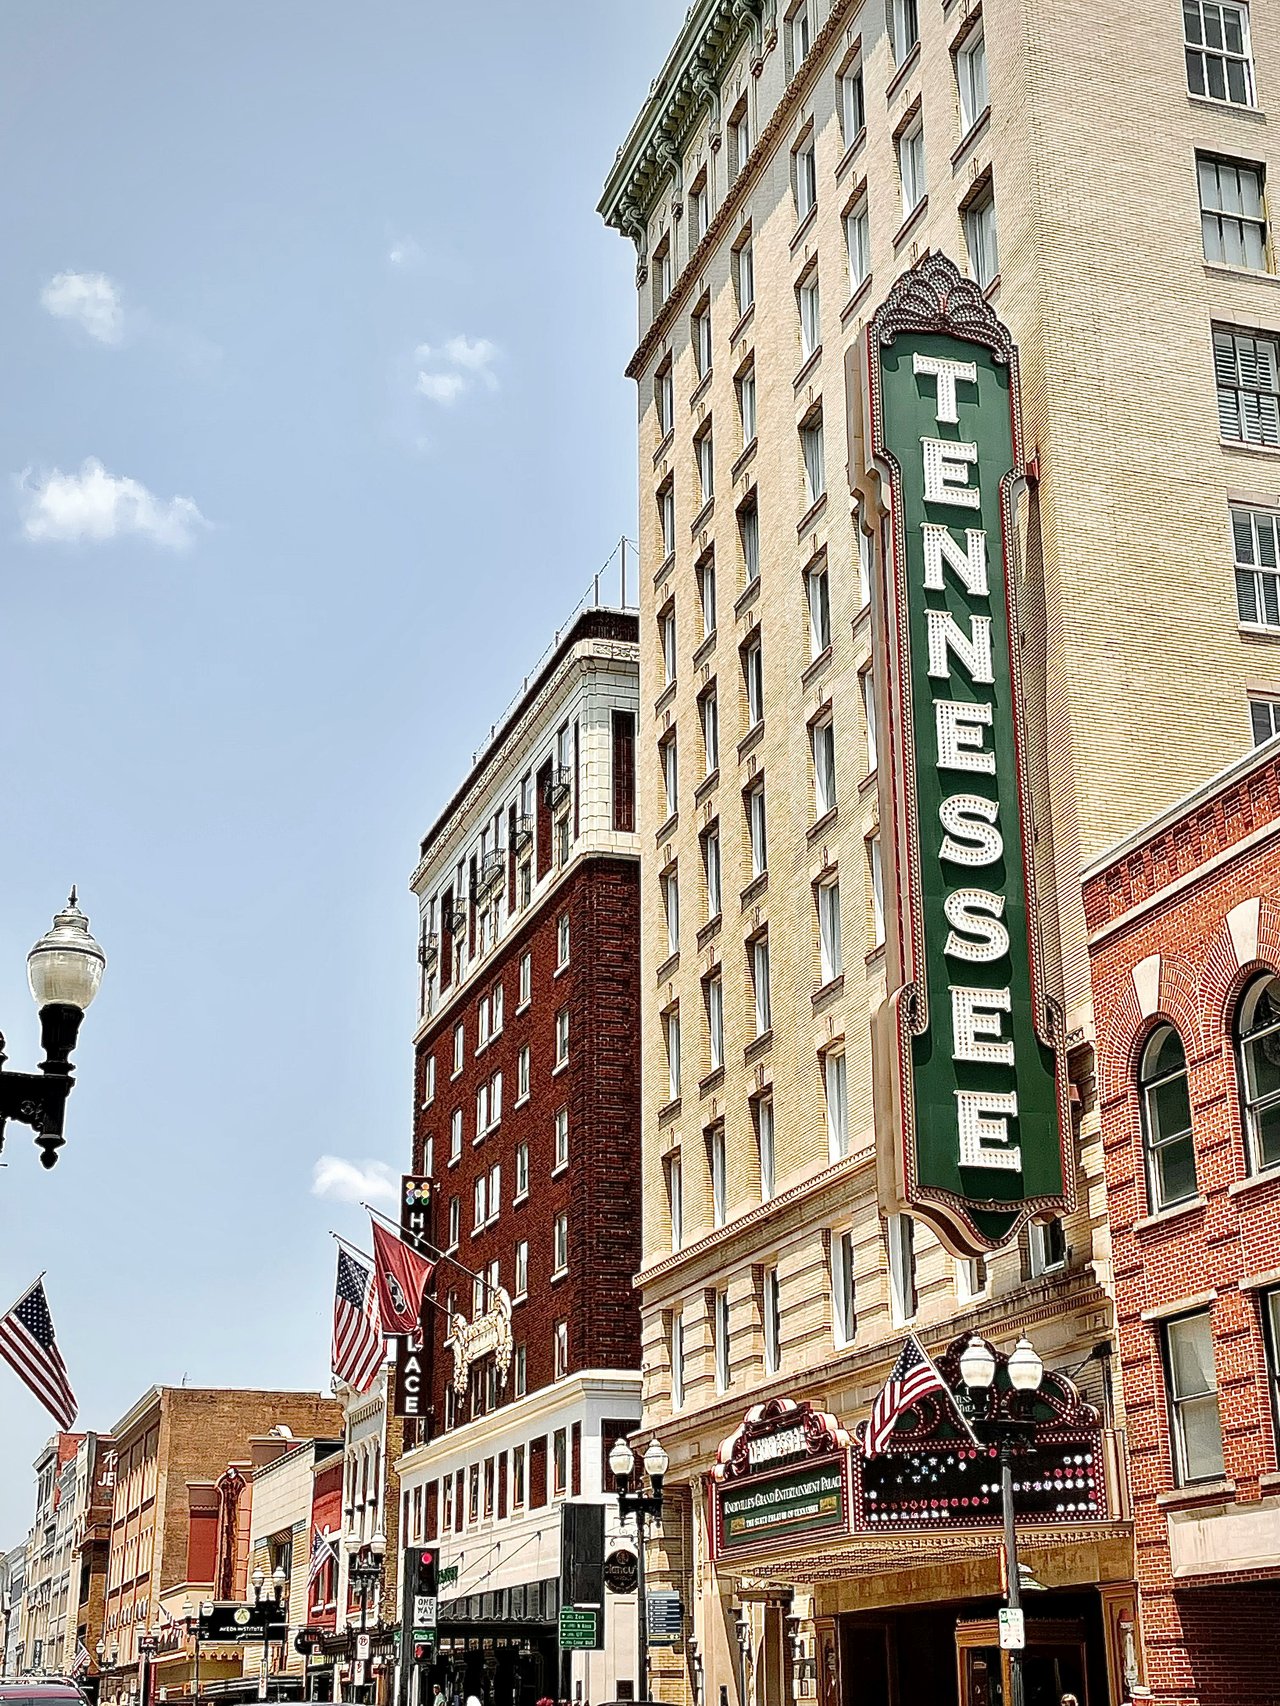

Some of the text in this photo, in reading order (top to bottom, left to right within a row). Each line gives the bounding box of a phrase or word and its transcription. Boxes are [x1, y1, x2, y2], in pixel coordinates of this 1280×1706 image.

[913, 352, 1022, 1172] TENNESSEE
[404, 1335, 421, 1413] LACE
[755, 1493, 775, 1507] GRAND
[775, 1480, 820, 1502] ENTERTAINMENT
[417, 1598, 434, 1606] ONE
[417, 1606, 434, 1614] WAY
